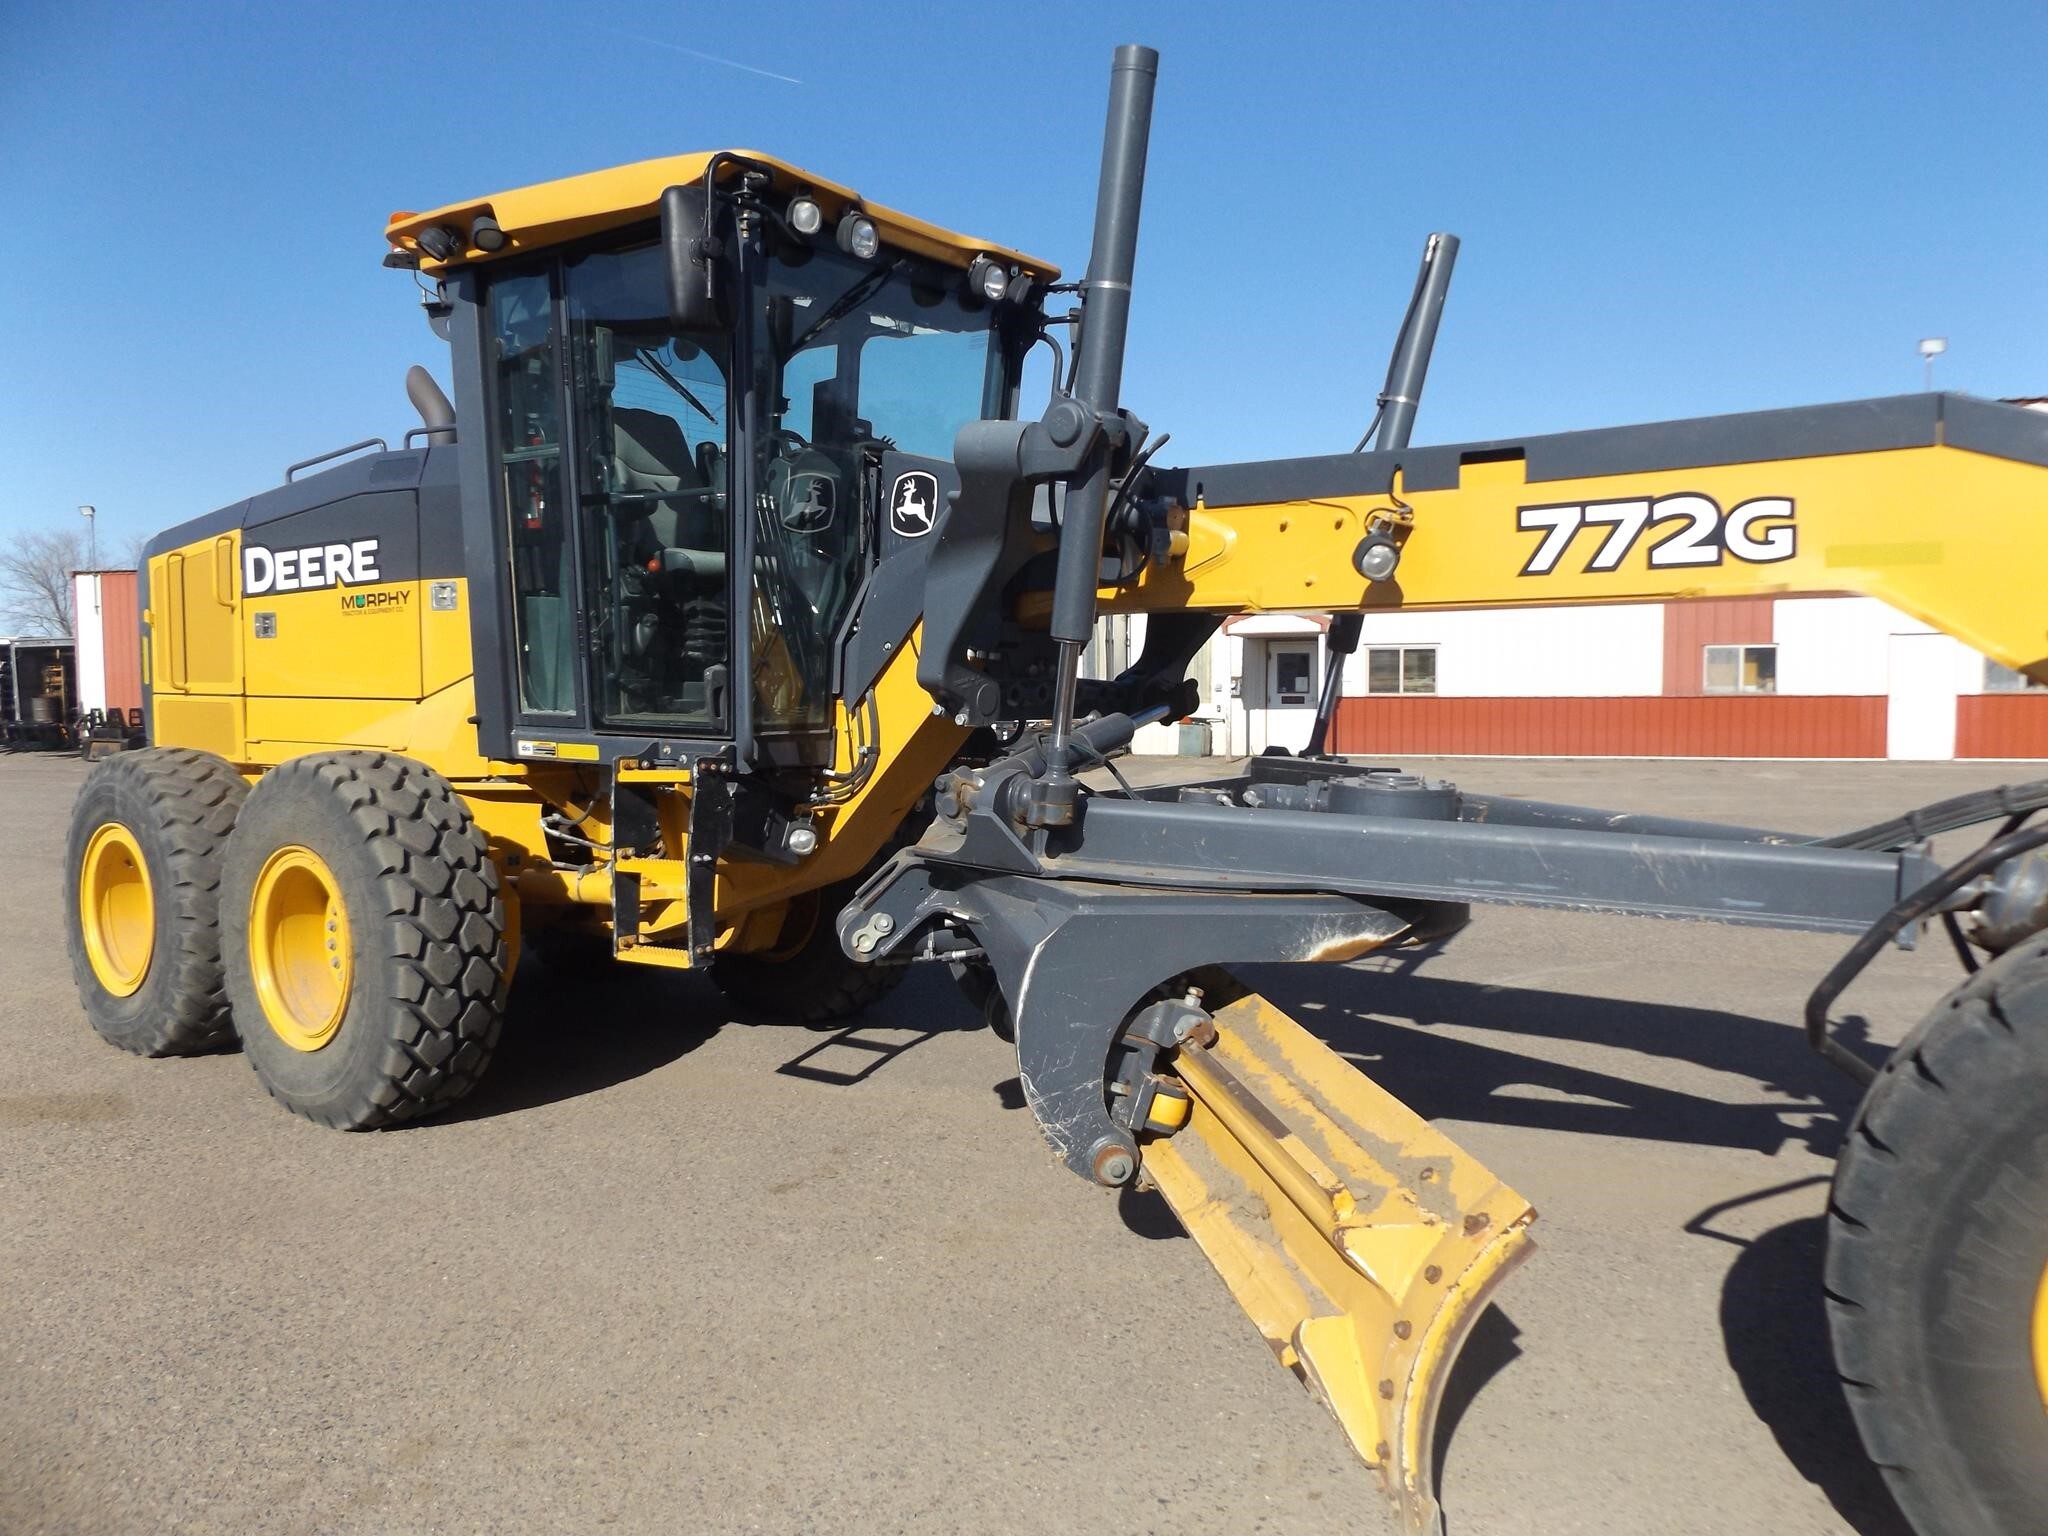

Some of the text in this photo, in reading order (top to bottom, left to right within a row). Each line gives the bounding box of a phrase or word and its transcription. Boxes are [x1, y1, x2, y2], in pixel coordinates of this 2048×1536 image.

[1517, 491, 1797, 576] 772G
[244, 539, 380, 594] DEERE
[341, 590, 411, 609] MURPHY
